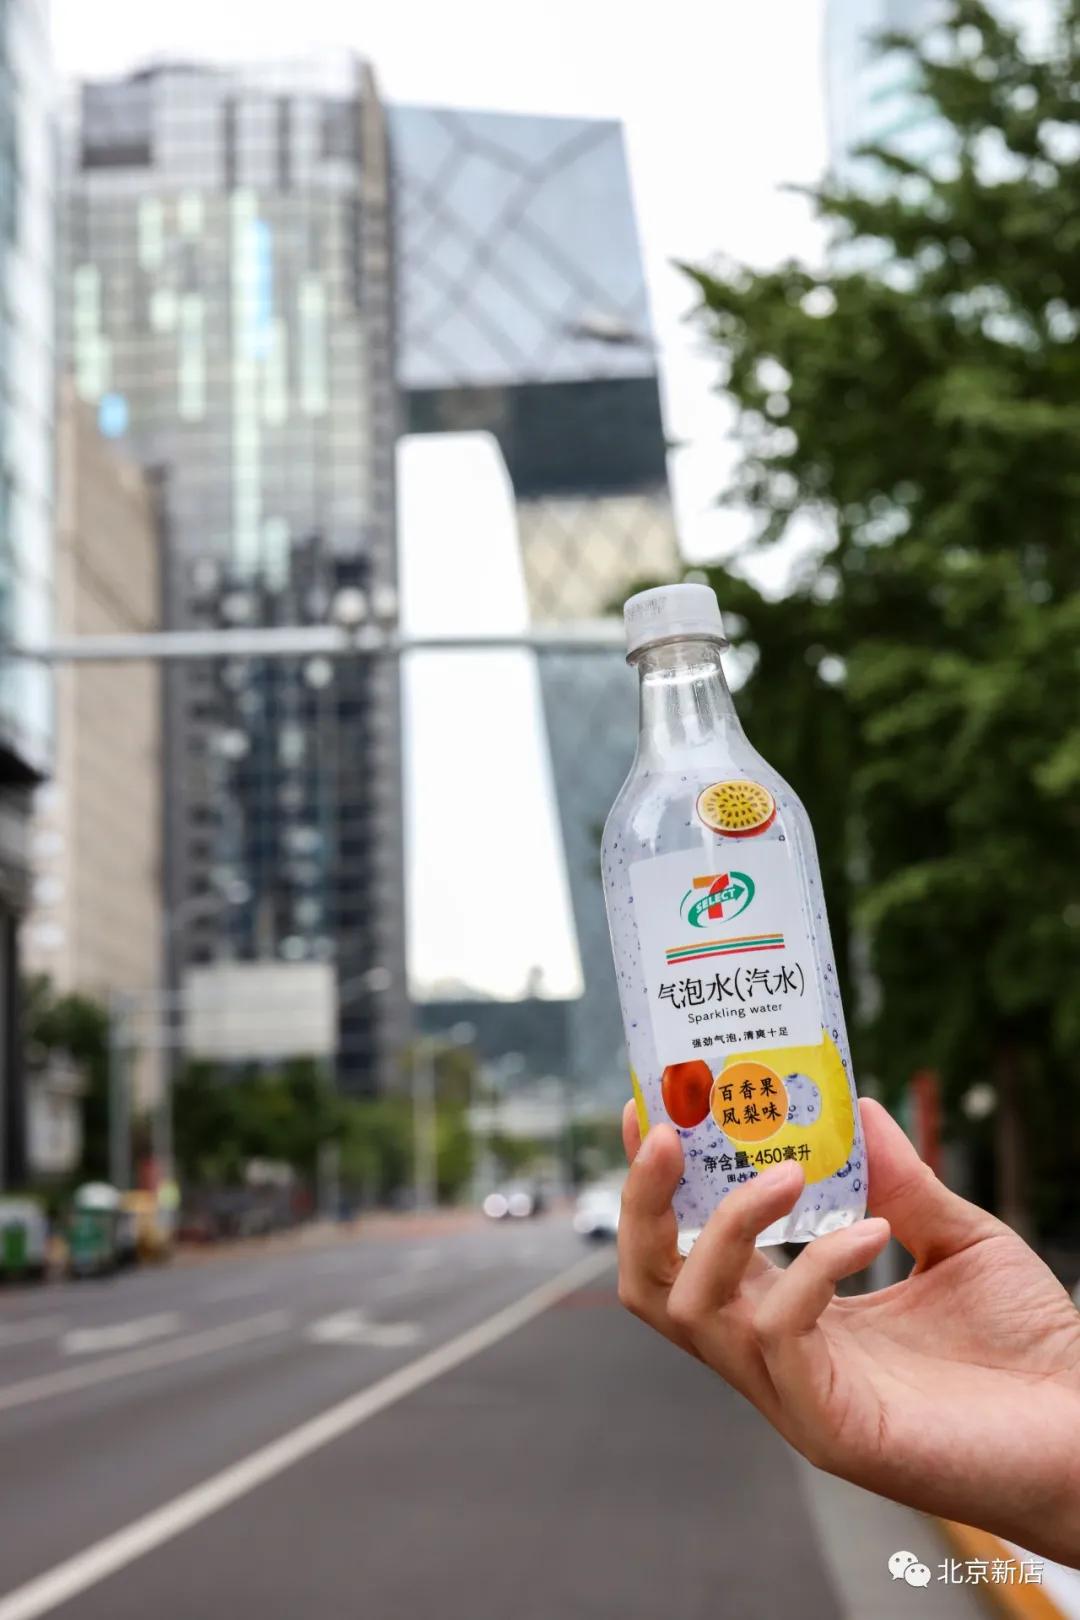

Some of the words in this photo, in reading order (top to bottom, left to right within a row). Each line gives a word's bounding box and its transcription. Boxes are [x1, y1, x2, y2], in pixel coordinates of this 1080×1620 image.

[695, 888, 736, 914] SELECT
[658, 963, 805, 1009] 气泡水(汽水)
[688, 1007, 746, 1025] Sparkling
[750, 1003, 783, 1014] water
[718, 1077, 778, 1102] 百香果
[722, 1102, 782, 1127] 凤梨味
[703, 1144, 811, 1174] 净含量:450毫升
